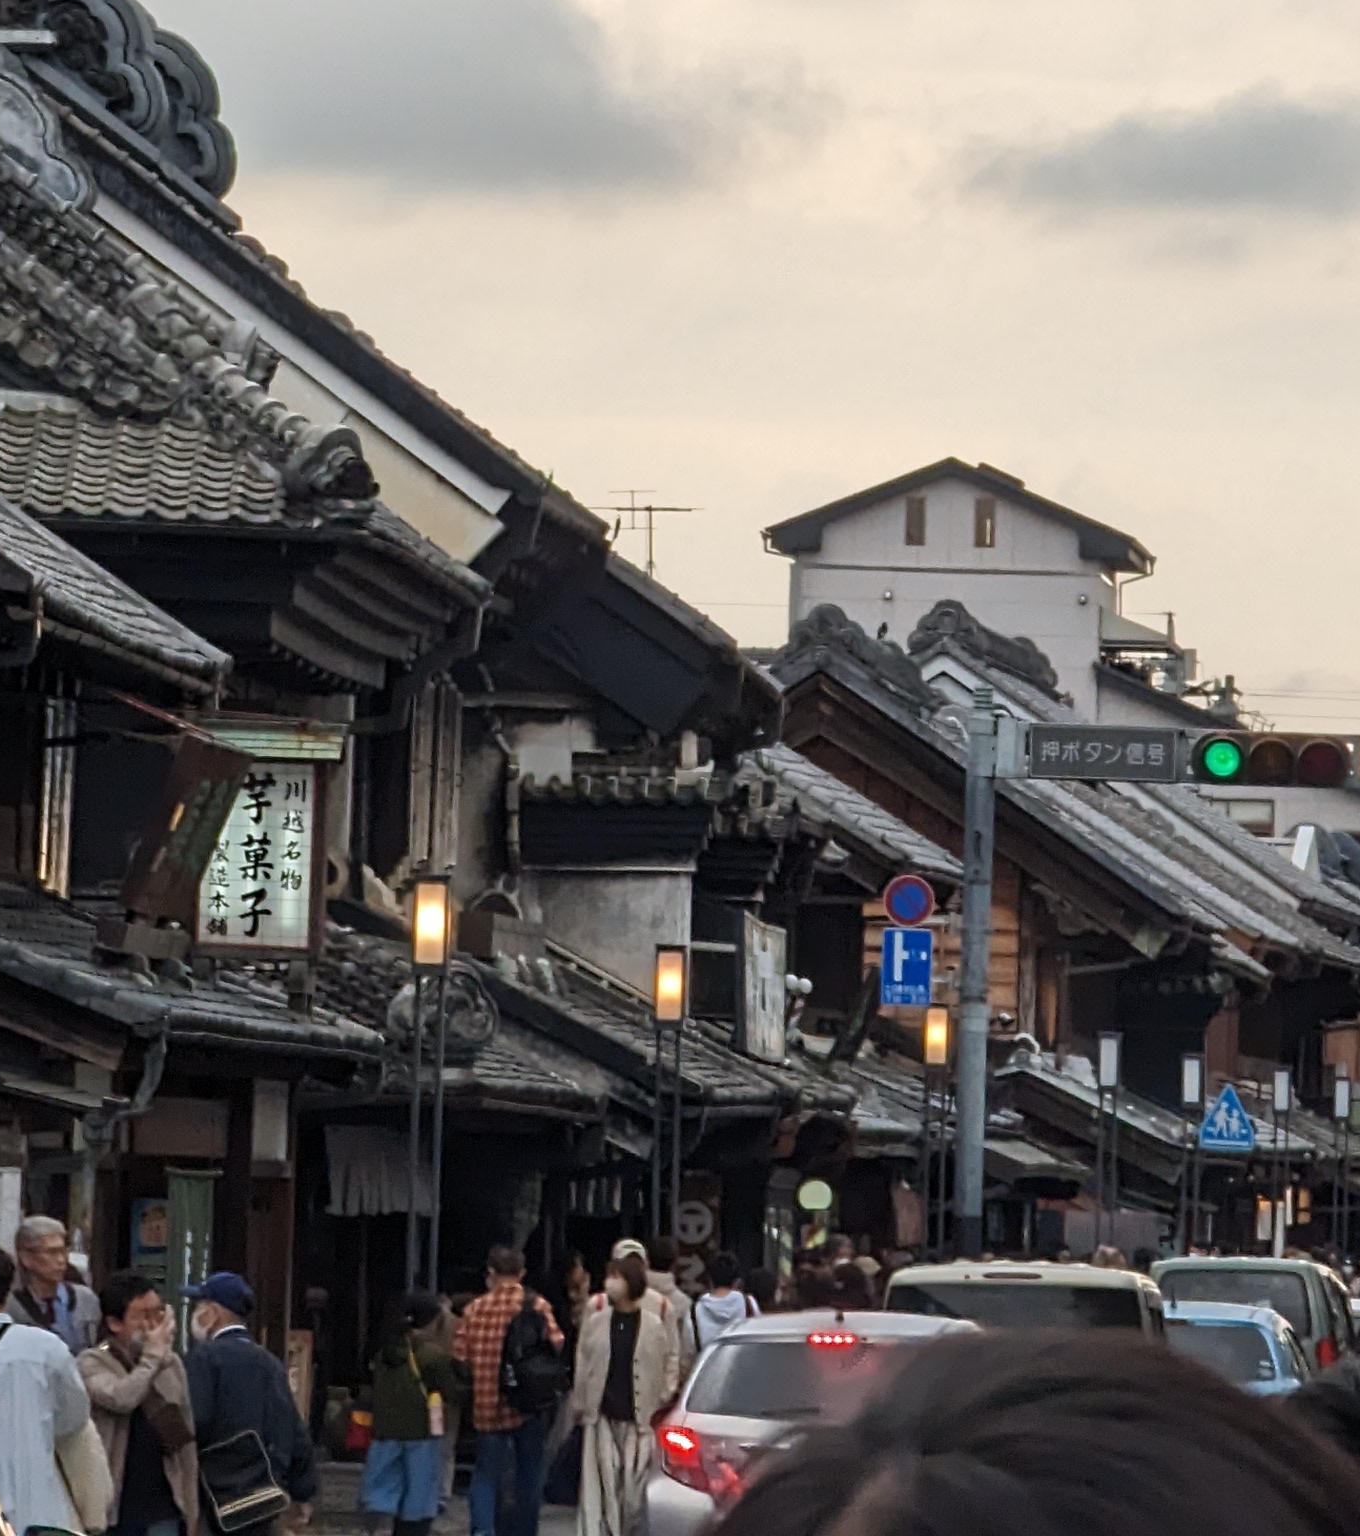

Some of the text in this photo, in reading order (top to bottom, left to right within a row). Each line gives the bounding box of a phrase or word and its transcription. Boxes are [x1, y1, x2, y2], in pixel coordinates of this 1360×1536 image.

[1041, 740, 1165, 765] 押ボタン信号
[238, 772, 276, 937] 芋菓子
[280, 779, 307, 891] 川越名物
